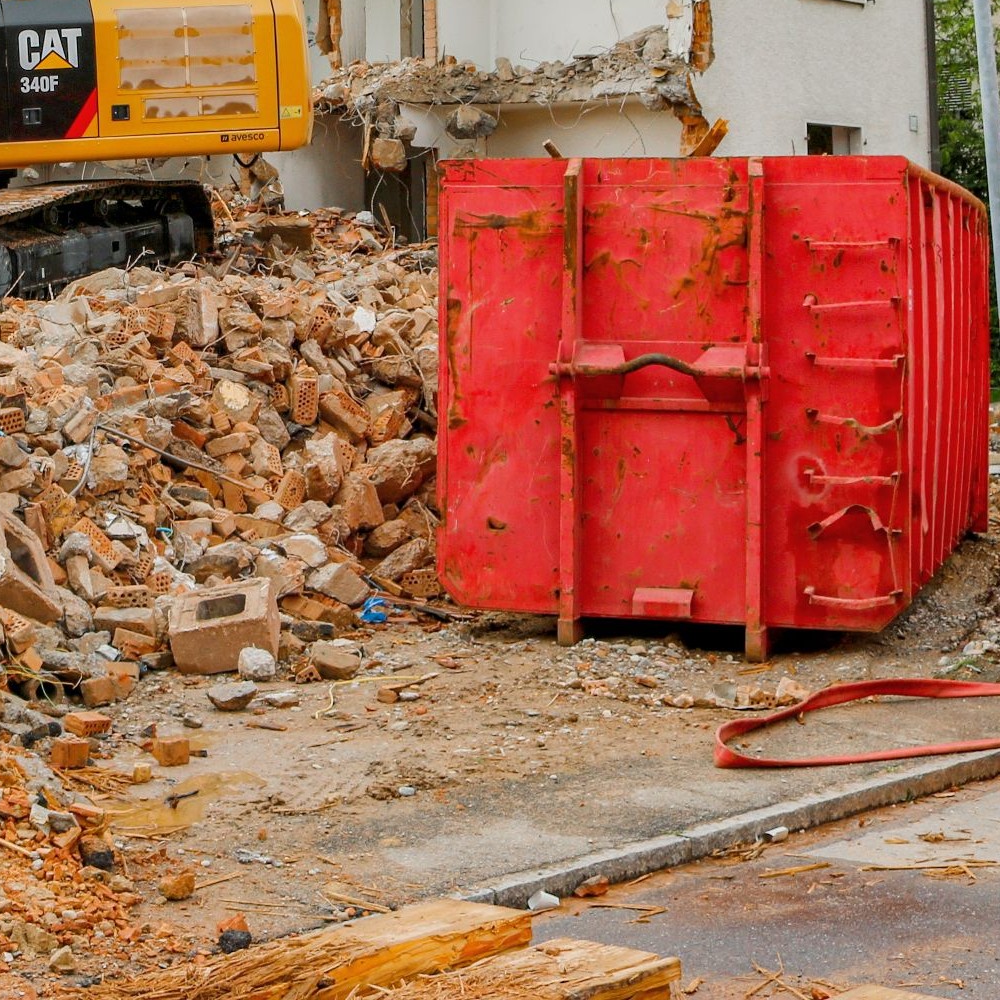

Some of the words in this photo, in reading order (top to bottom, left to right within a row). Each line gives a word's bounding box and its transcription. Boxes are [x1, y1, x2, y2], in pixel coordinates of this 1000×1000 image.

[18, 27, 82, 71] CAT
[20, 75, 59, 93] 340F
[230, 132, 265, 142] avesco
